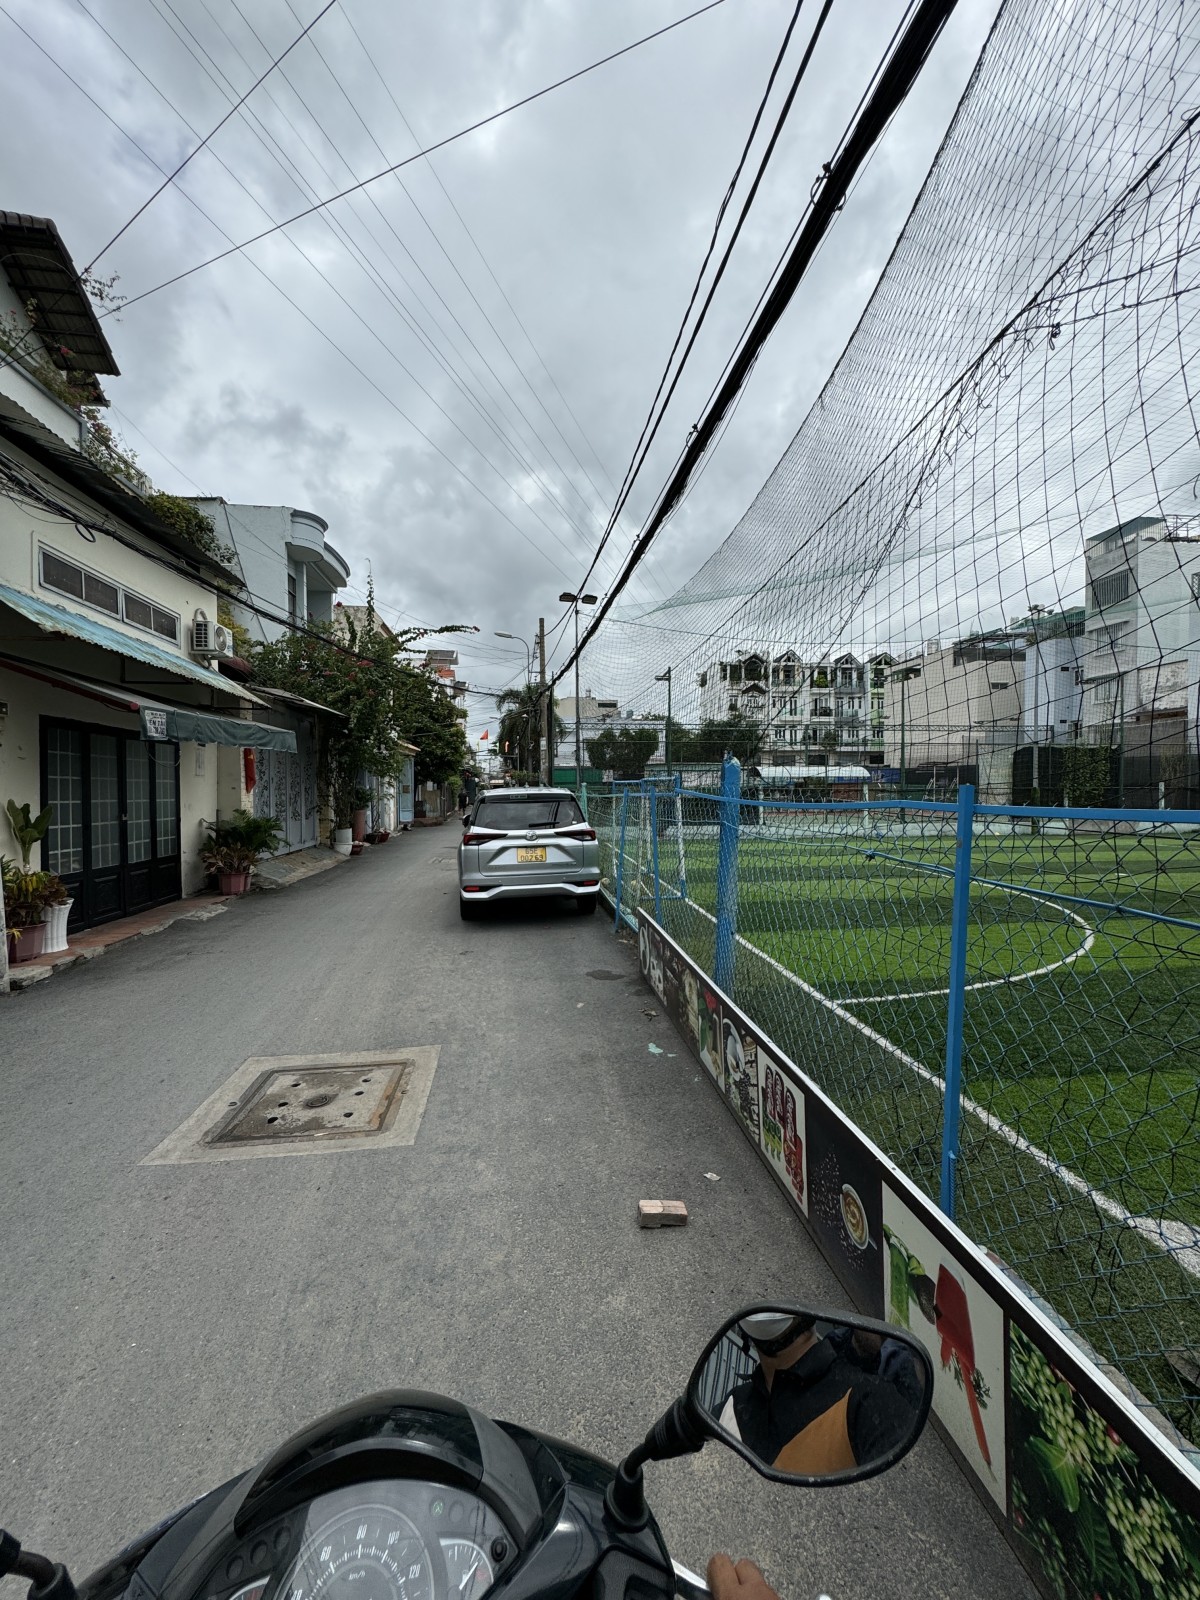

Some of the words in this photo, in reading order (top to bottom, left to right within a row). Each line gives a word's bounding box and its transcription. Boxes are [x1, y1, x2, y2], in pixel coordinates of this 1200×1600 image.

[356, 1524, 367, 1540] 80
[320, 1546, 332, 1562] 60
[408, 1564, 421, 1579] 120
